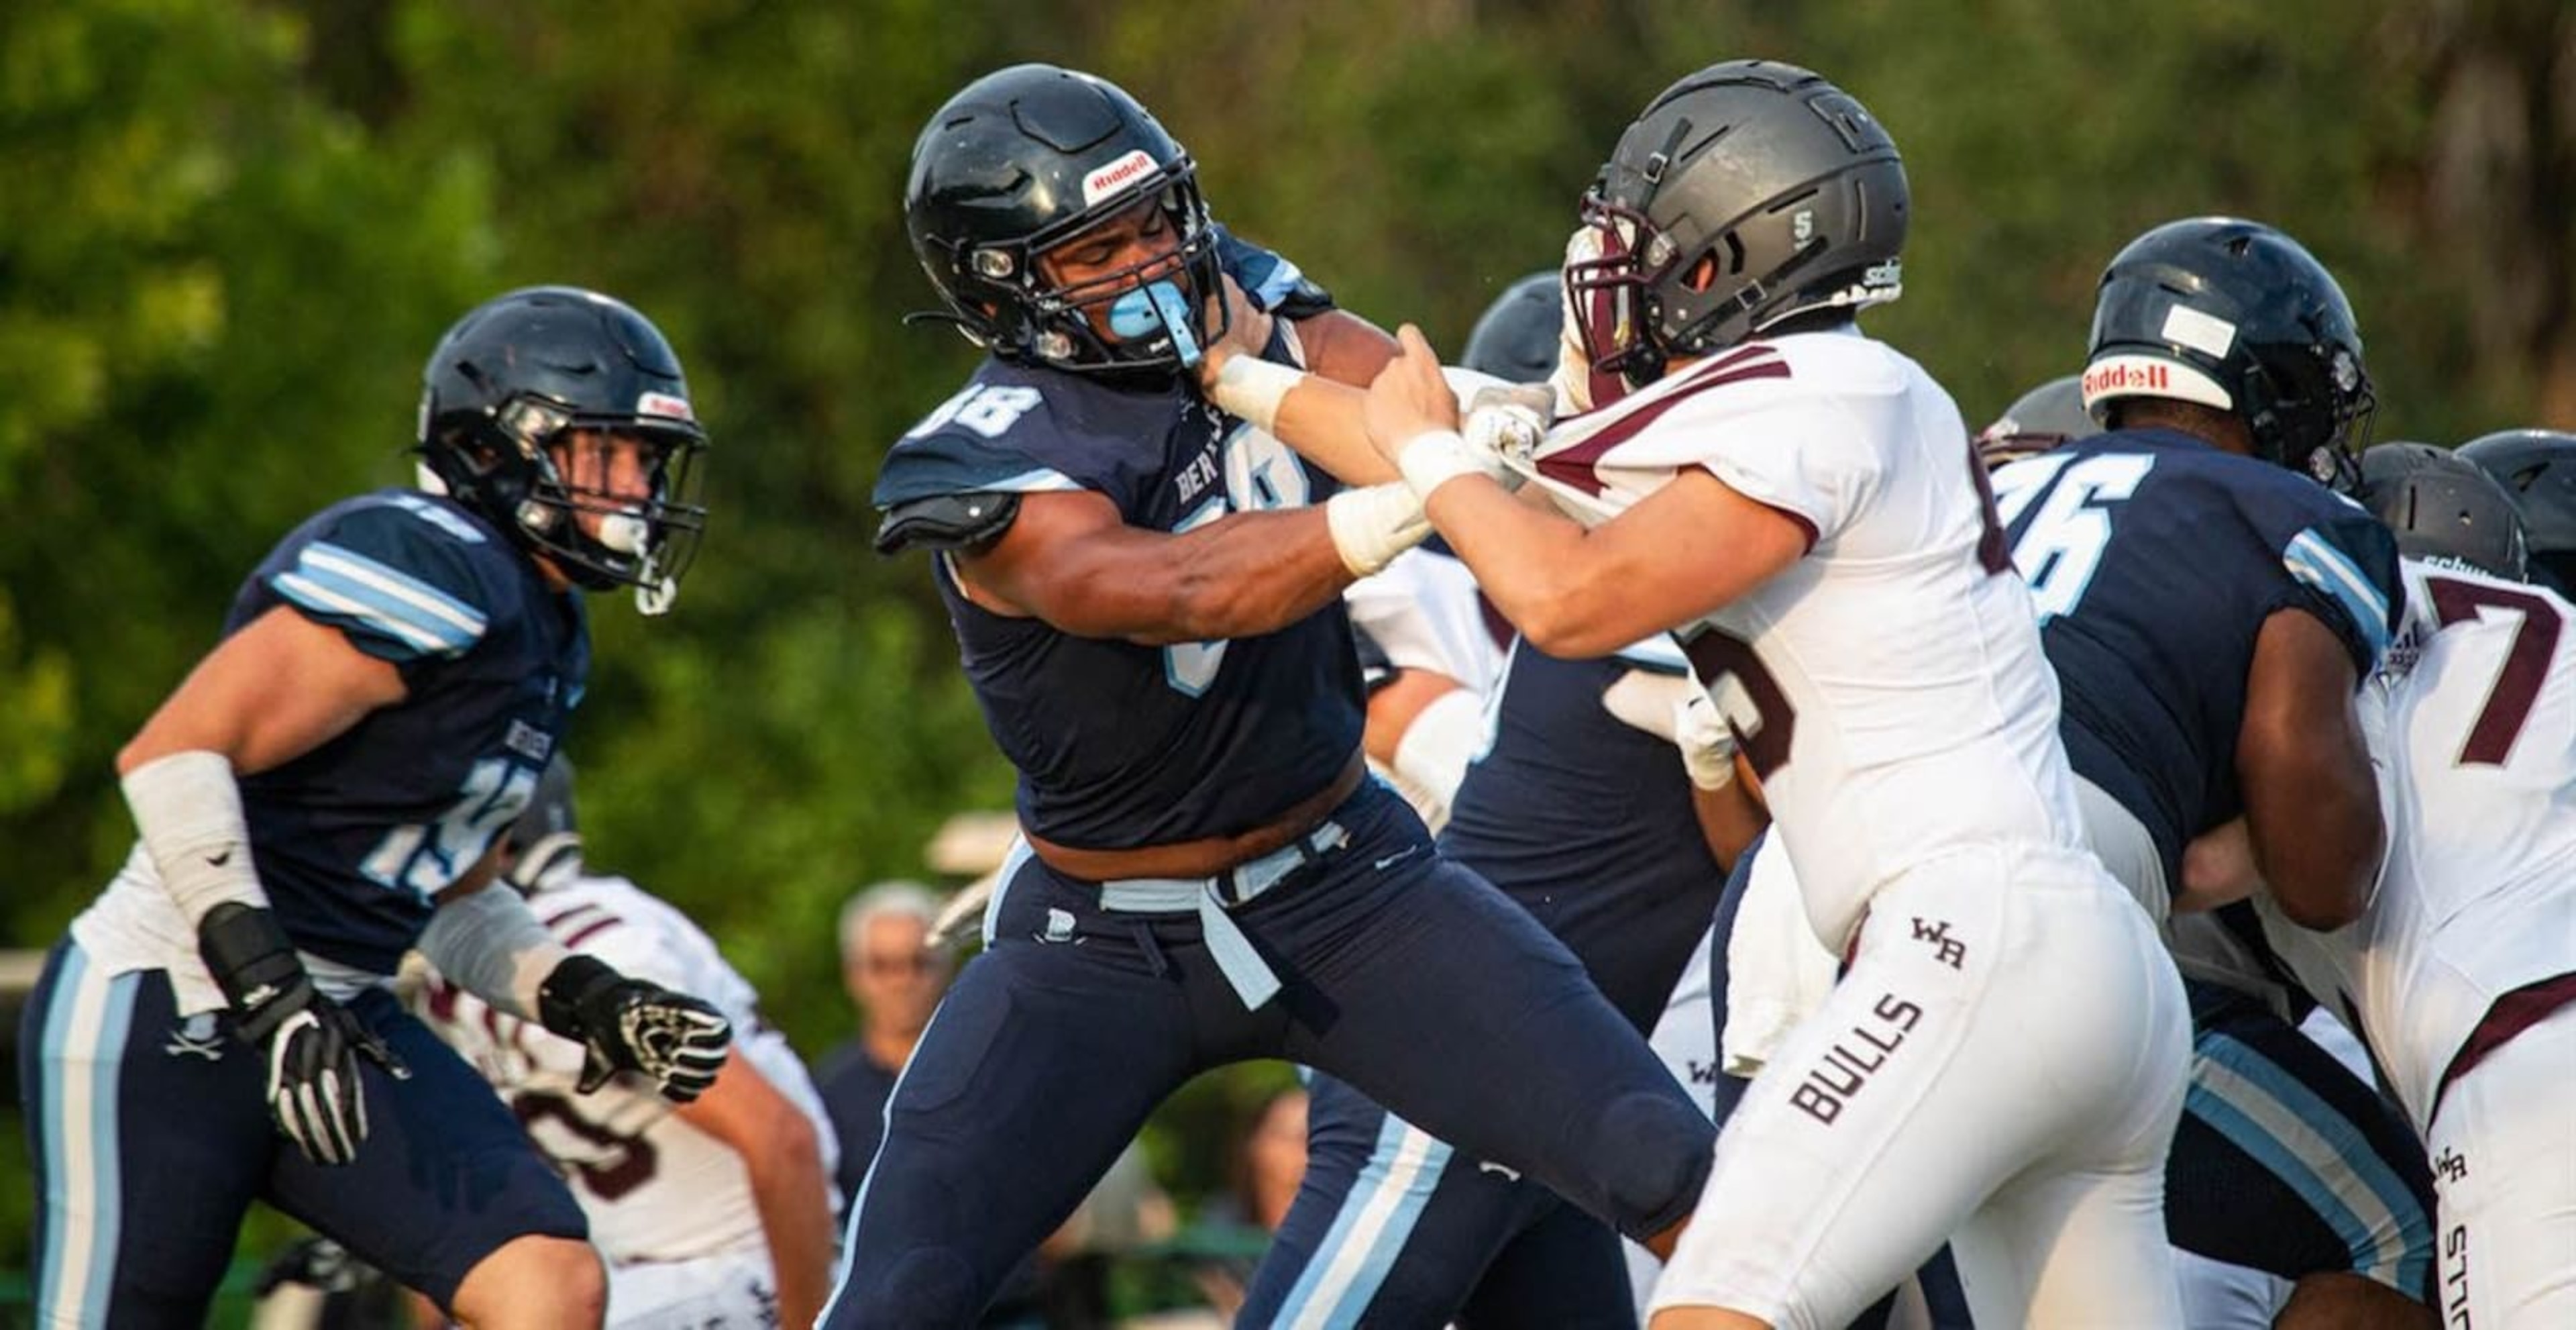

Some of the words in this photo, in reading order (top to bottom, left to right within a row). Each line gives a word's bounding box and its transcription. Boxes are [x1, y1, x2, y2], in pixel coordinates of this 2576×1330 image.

[1093, 154, 1148, 190] Riddell
[2424, 576, 2564, 766] 7
[1789, 992, 1923, 1126] BULLS
